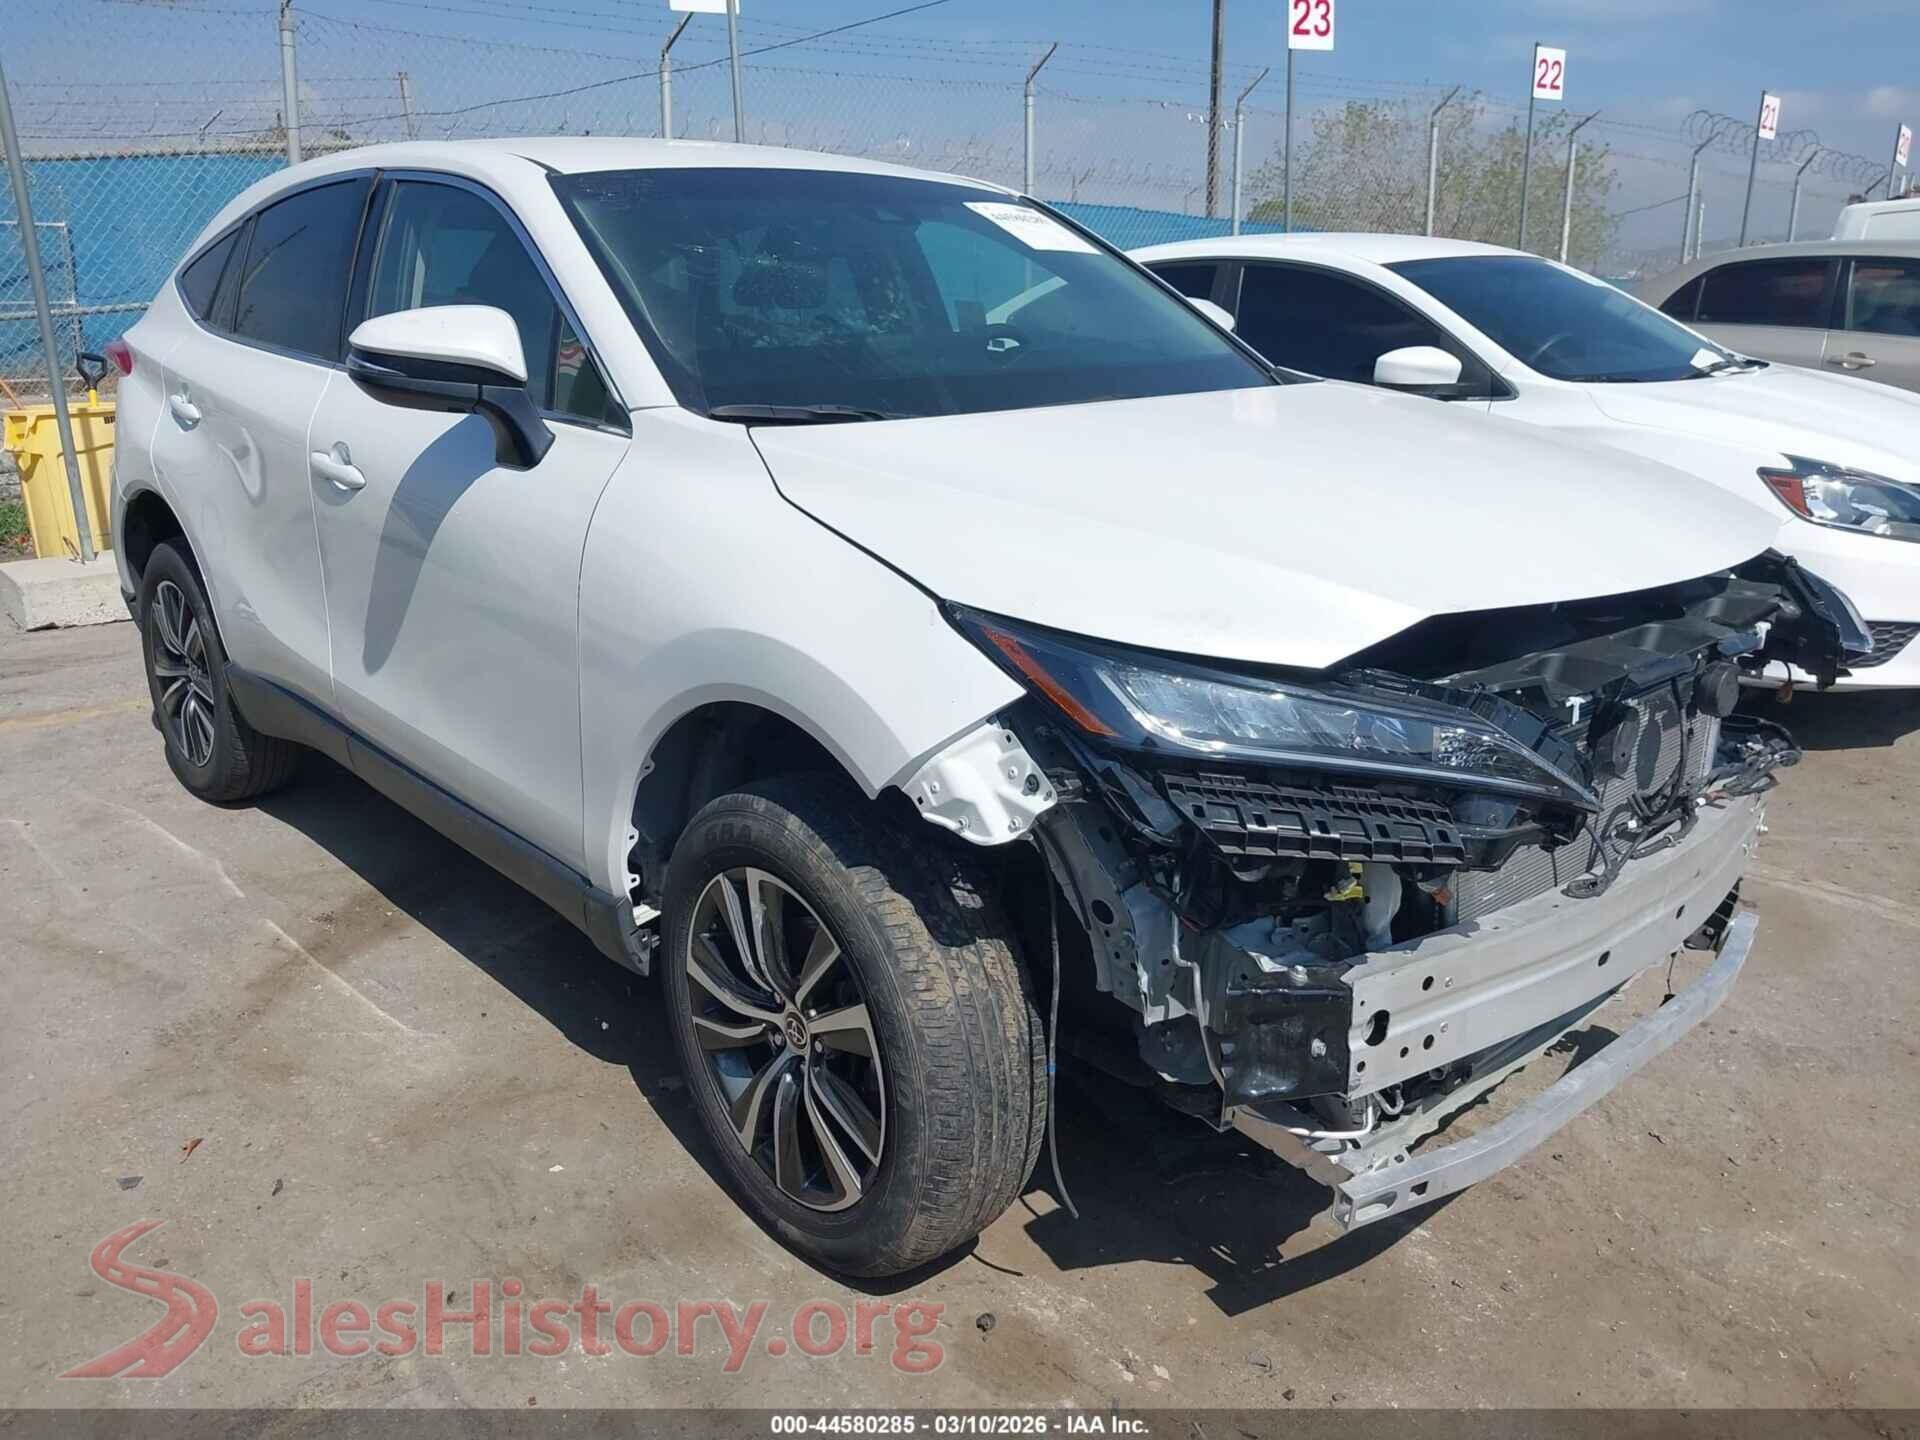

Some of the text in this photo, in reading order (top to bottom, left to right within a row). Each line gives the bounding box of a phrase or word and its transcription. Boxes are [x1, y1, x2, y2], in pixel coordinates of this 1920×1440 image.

[1293, 0, 1331, 37] 23
[1536, 58, 1562, 90] 22
[1761, 104, 1776, 131] 21
